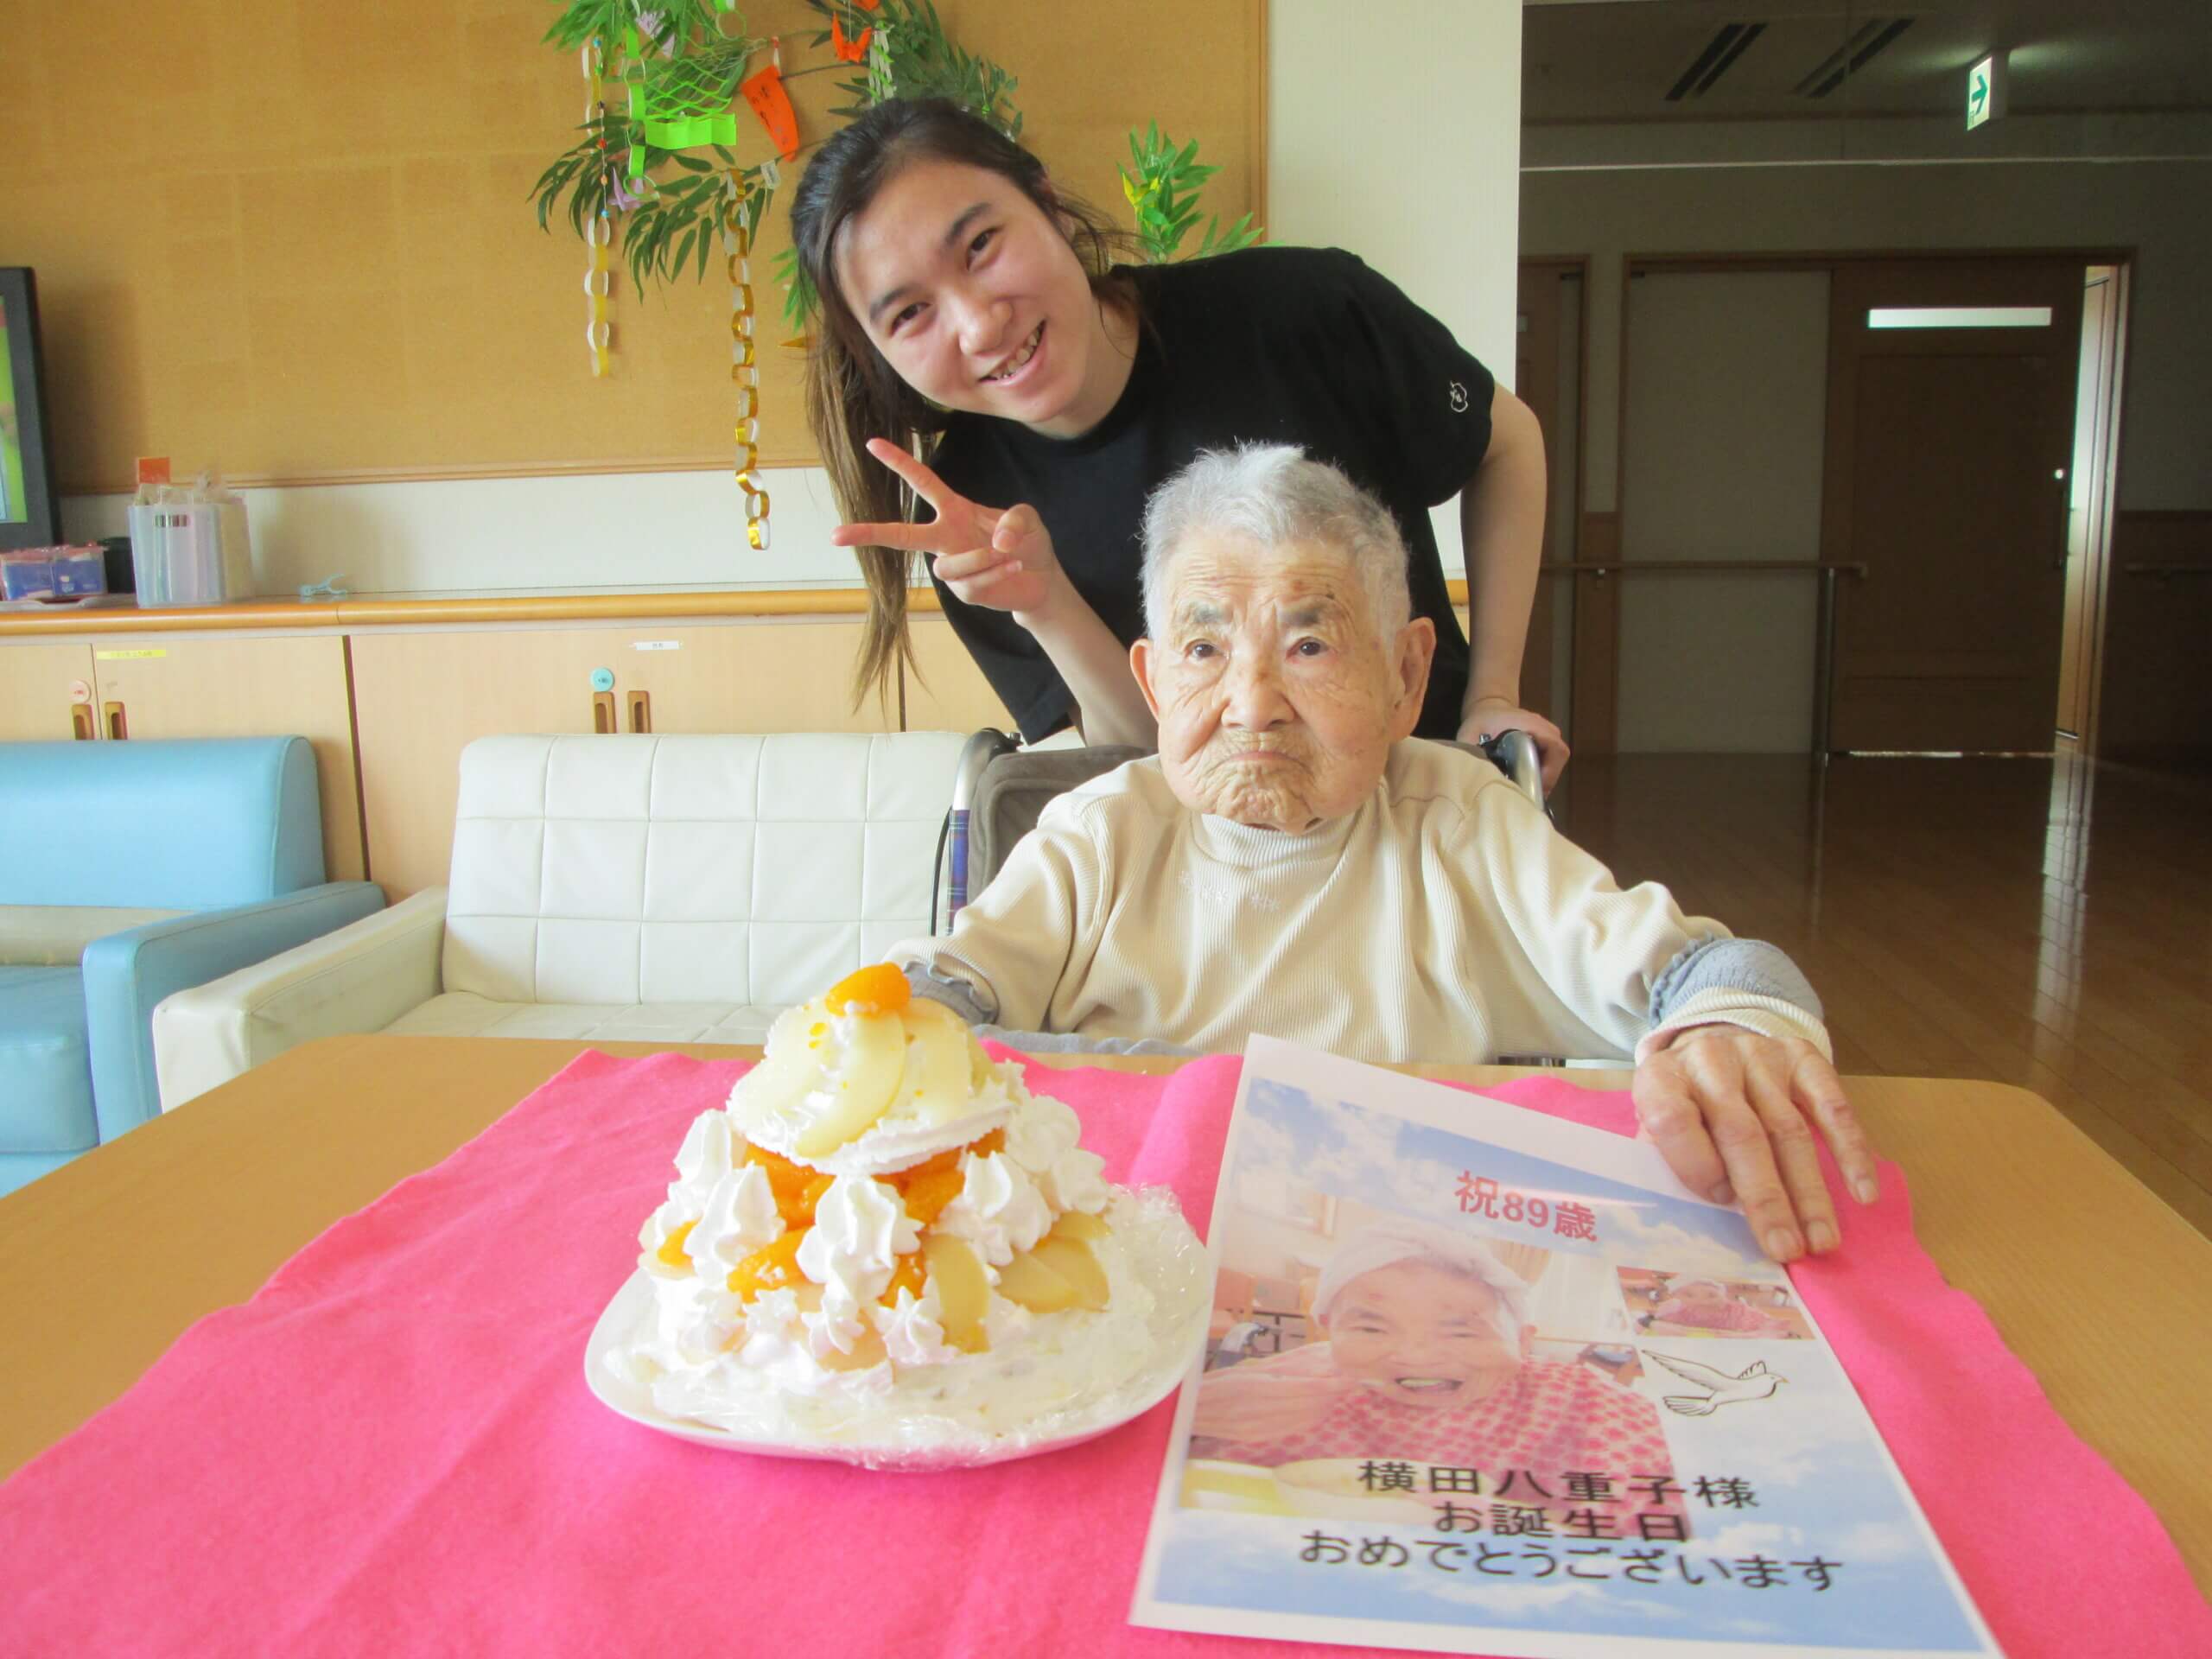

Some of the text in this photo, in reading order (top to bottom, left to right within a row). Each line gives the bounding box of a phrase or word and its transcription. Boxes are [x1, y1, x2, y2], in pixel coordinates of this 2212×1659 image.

[1454, 1170, 1598, 1243] 祝89歳
[1357, 1460, 1760, 1509] 横田八重子様
[1433, 1501, 1687, 1542] お誕生日
[1299, 1529, 1843, 1592] おめでとうございます
